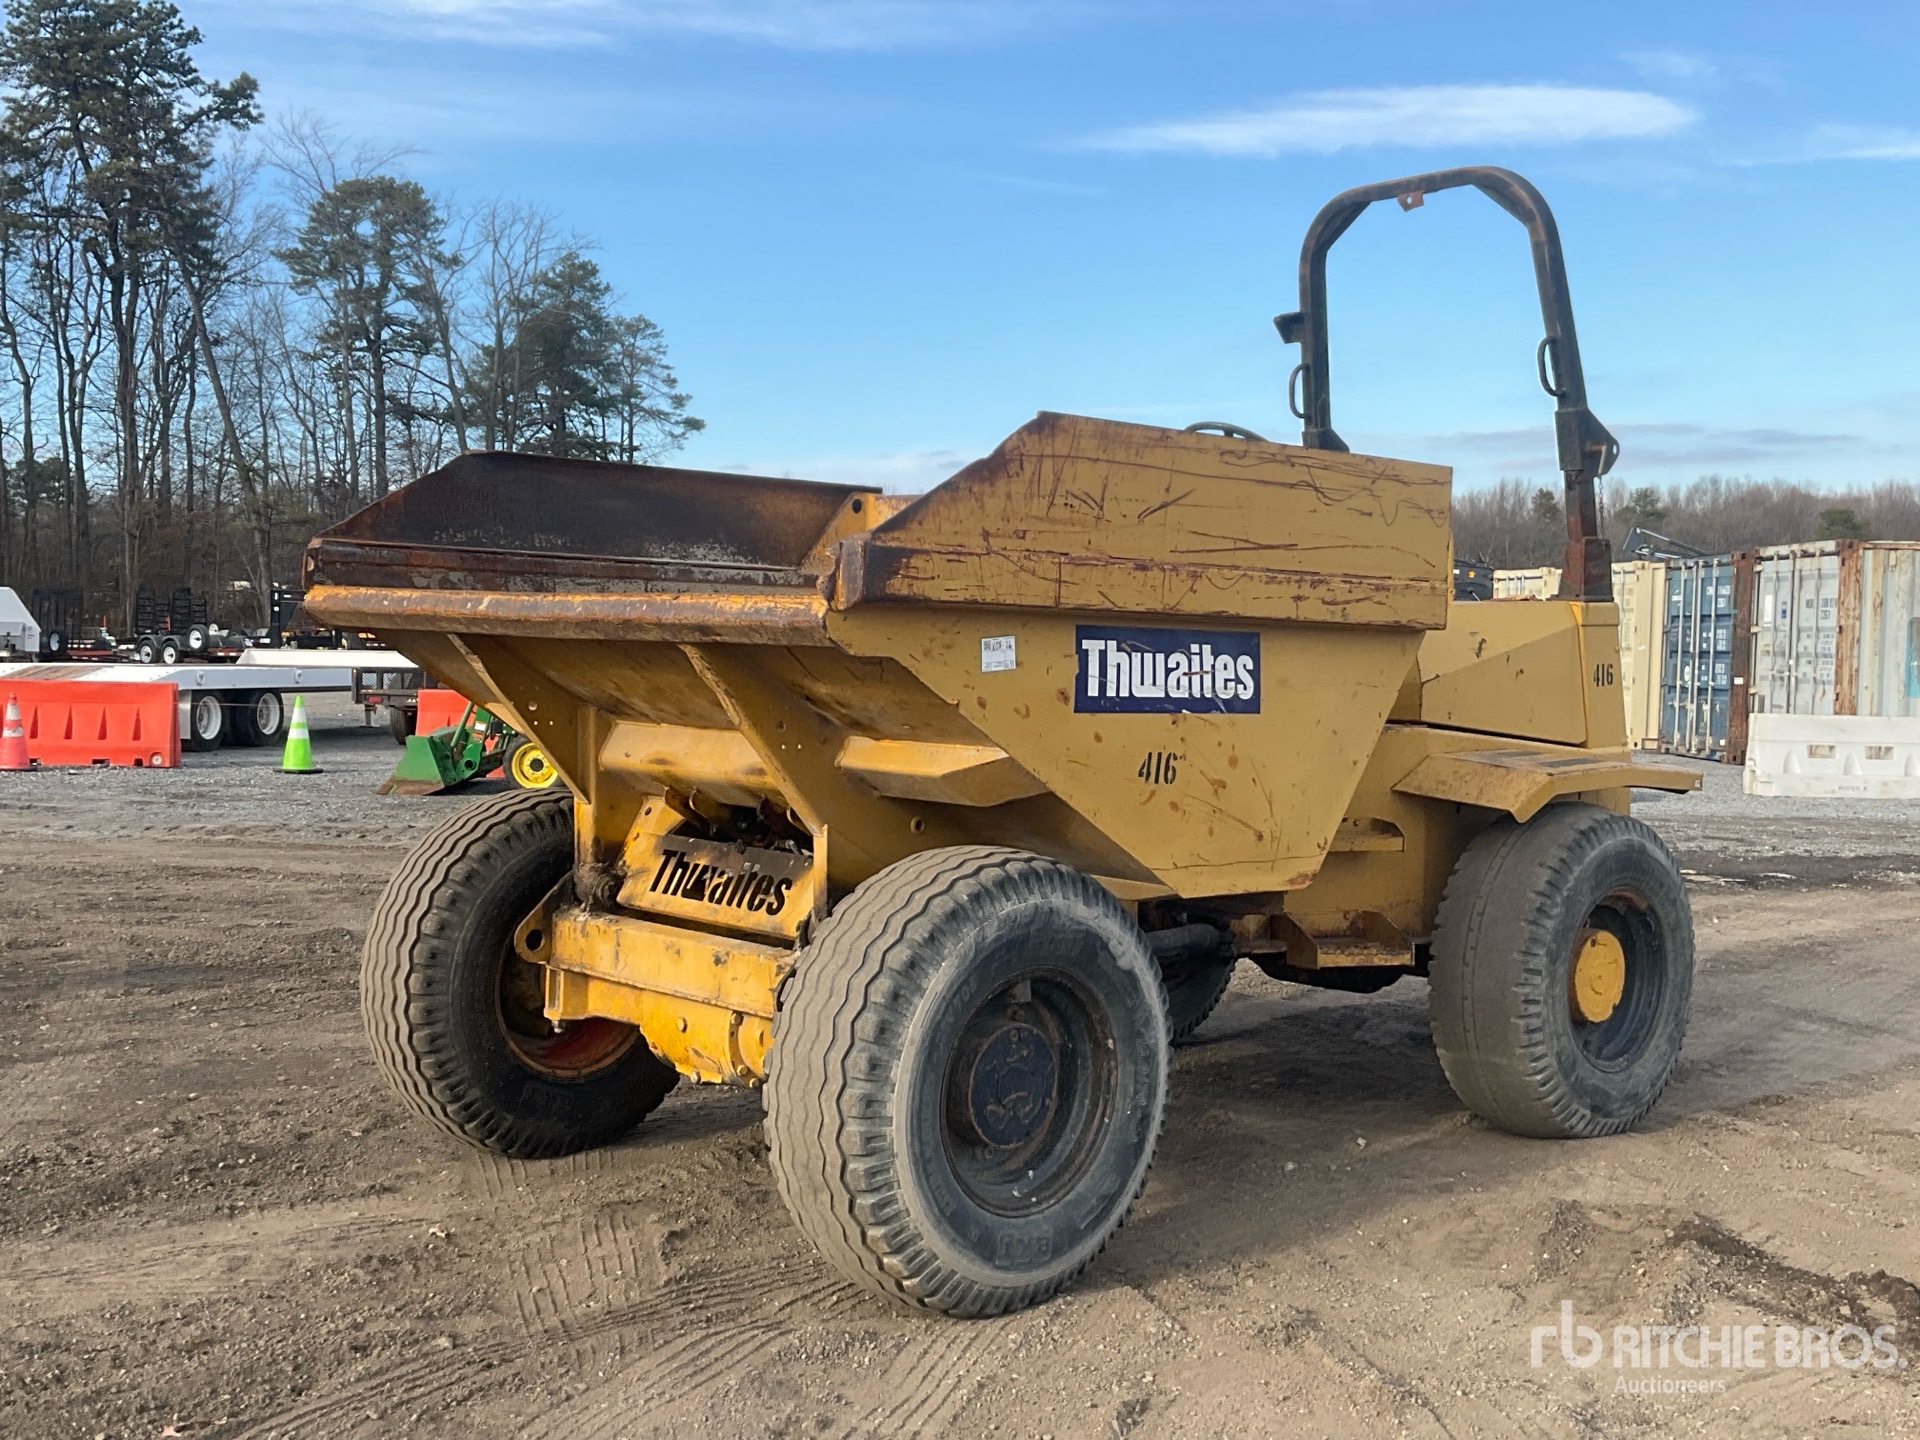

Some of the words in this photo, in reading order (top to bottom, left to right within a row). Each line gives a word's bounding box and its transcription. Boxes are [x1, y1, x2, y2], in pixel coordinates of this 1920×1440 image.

[1081, 639, 1254, 699] Thwaites
[1593, 663, 1614, 687] 416
[1137, 751, 1178, 785] 416
[649, 848, 793, 916] Thwaites
